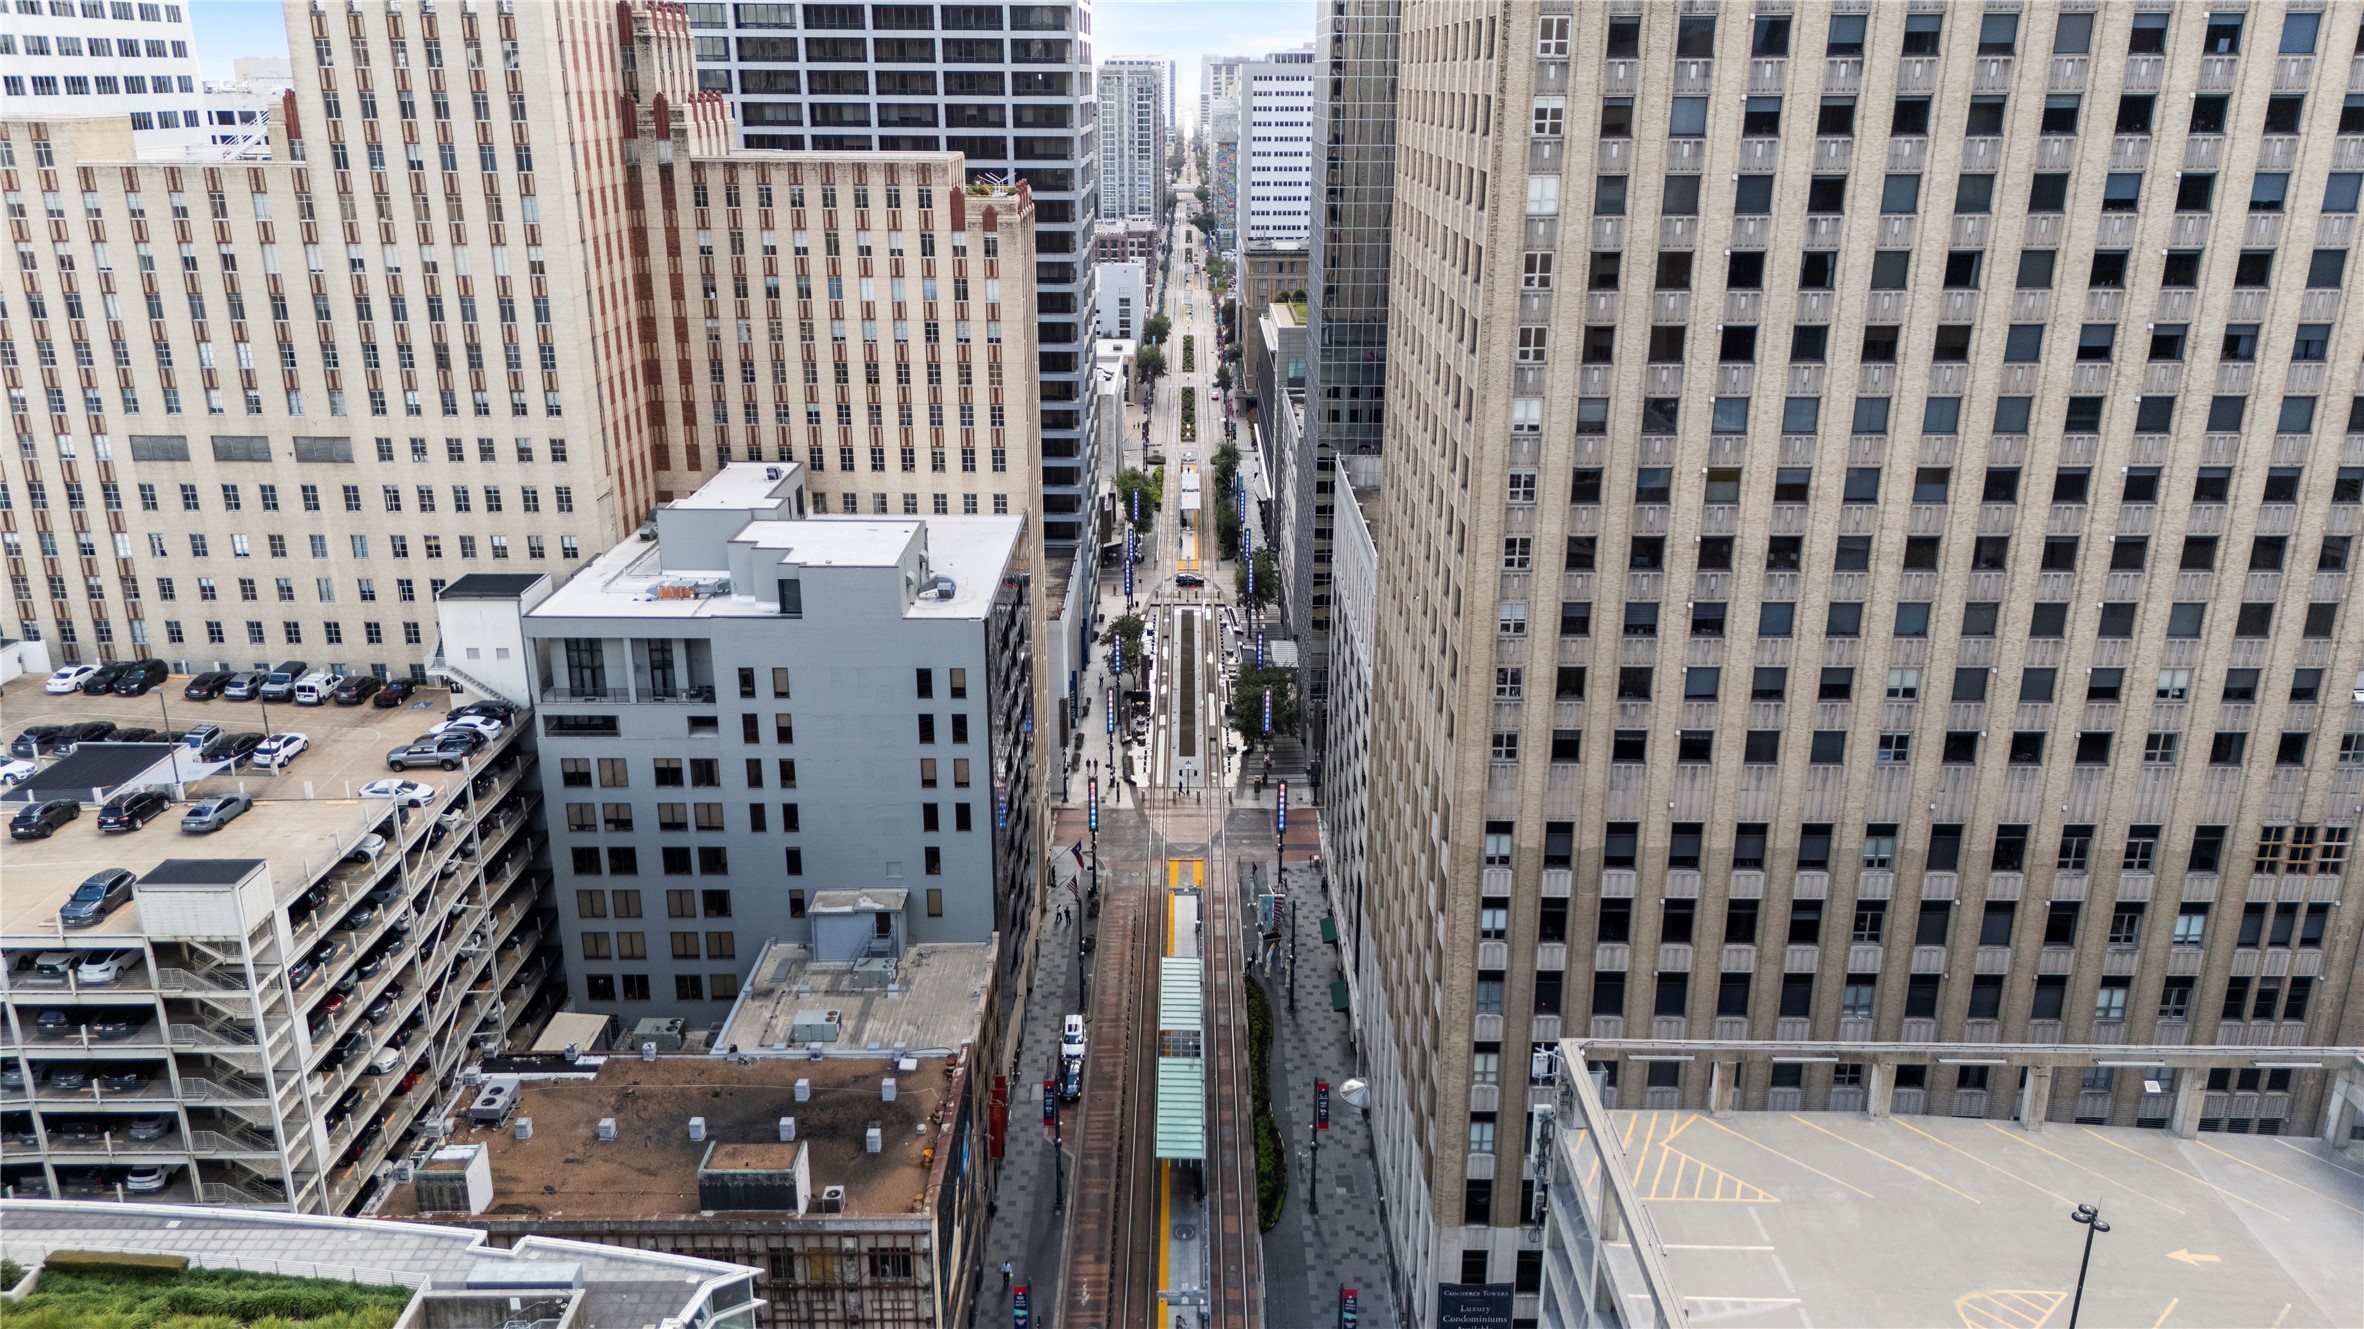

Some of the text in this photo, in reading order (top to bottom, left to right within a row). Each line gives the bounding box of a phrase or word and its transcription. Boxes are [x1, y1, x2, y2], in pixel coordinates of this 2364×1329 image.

[451, 682, 462, 692] 11
[1460, 1304, 1491, 1313] Luxury
[1442, 1314, 1508, 1323] Condominiums
